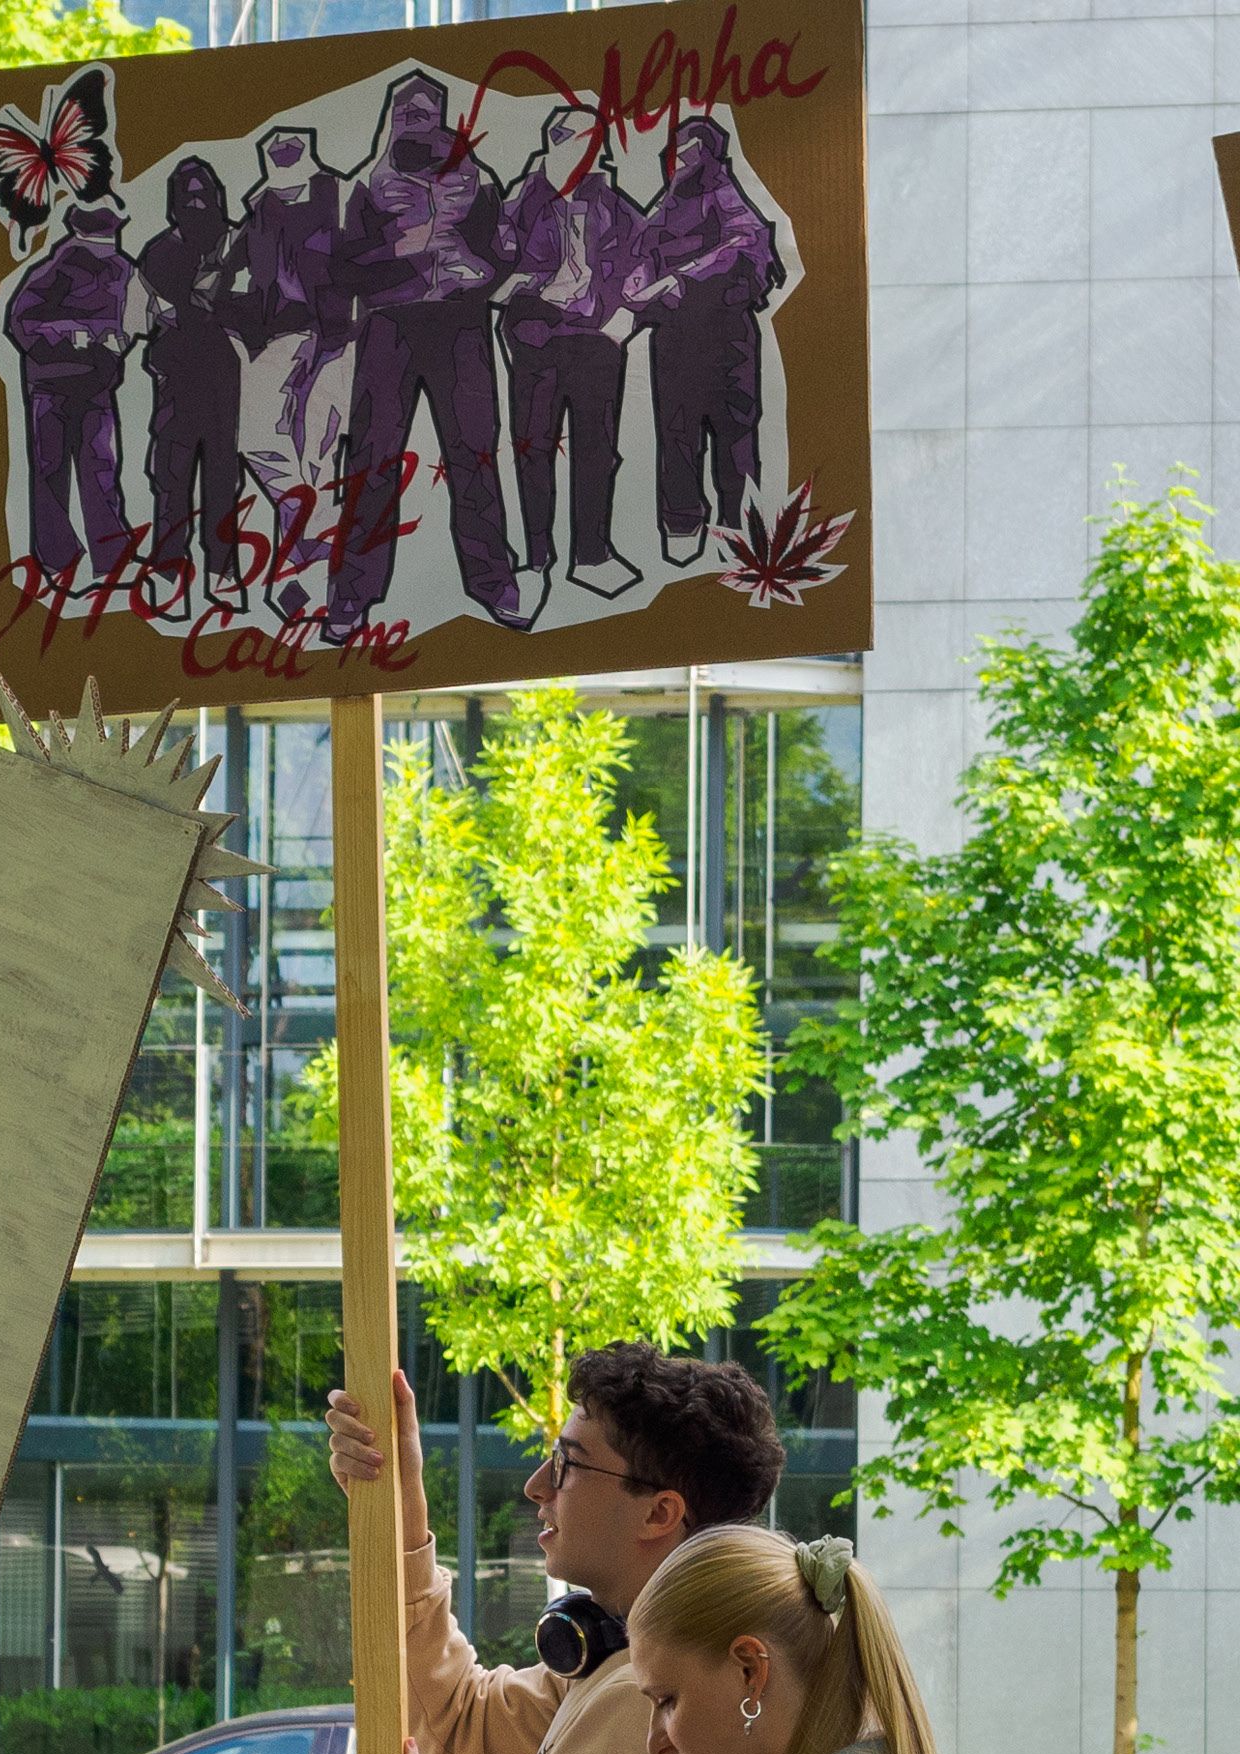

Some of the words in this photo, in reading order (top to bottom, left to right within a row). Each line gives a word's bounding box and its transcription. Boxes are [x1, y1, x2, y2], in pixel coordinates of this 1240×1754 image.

[553, 4, 831, 199] Alpha
[181, 601, 328, 679] Call
[338, 618, 420, 674] me
